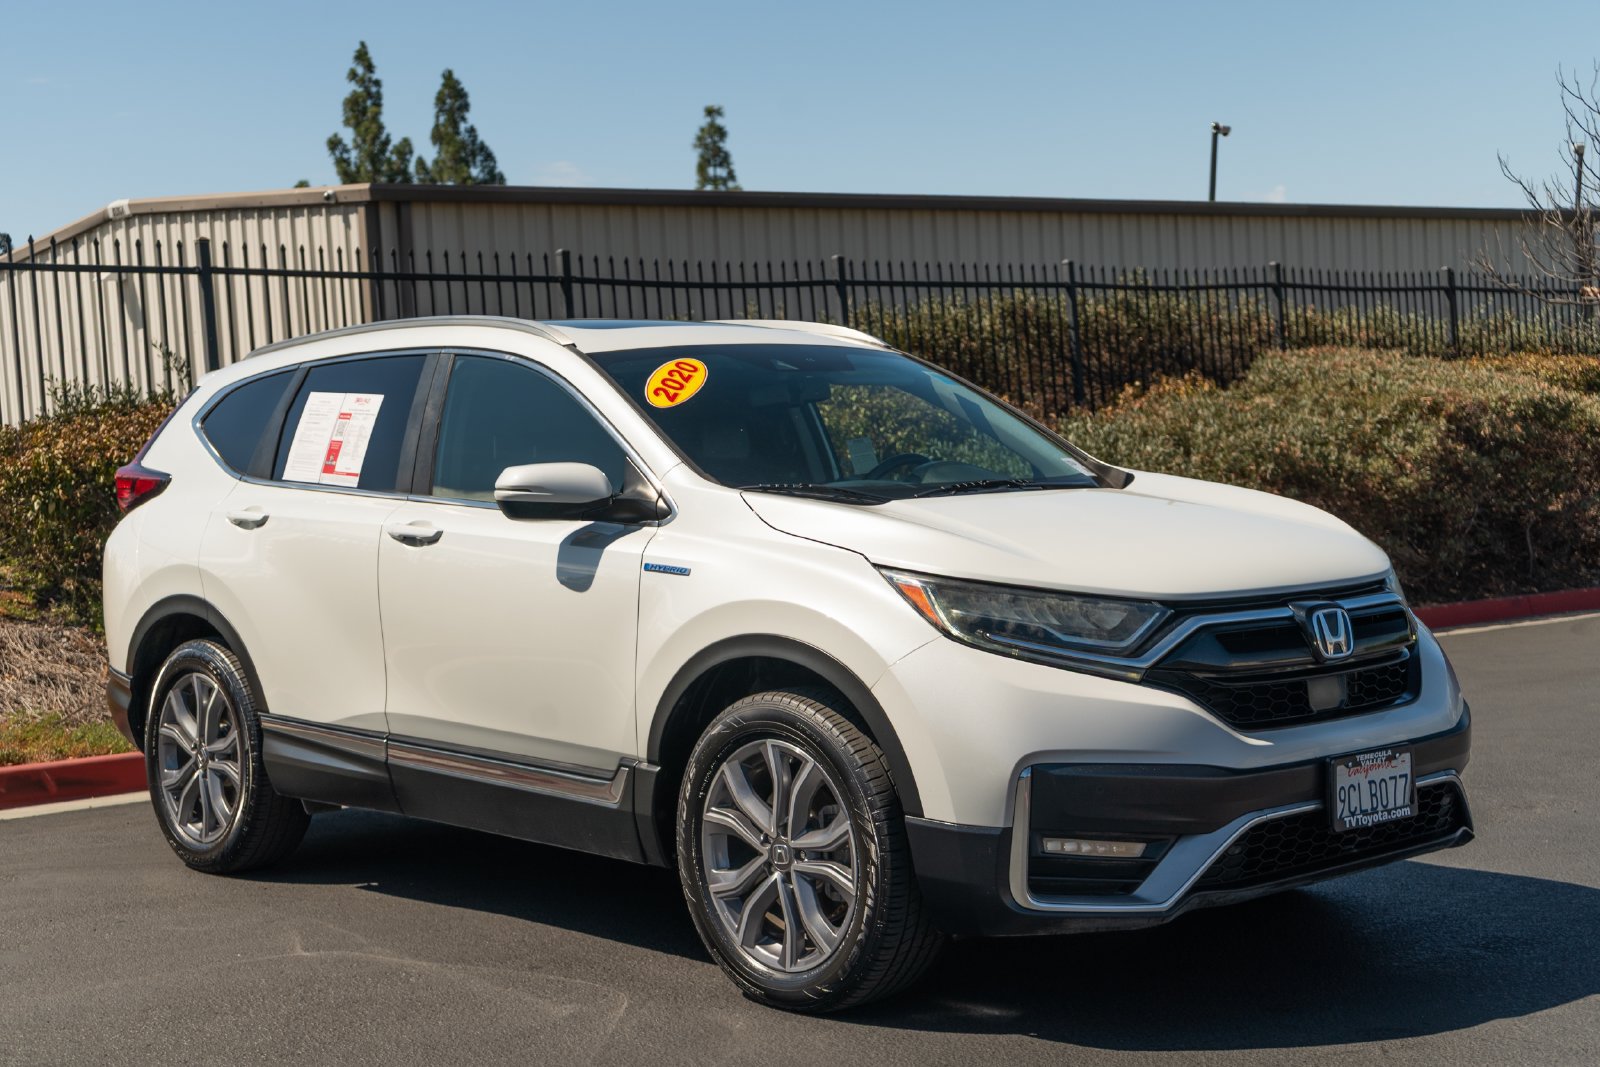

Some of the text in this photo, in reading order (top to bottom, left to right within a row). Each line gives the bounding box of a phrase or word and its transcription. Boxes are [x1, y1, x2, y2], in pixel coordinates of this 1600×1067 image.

[653, 361, 699, 403] 2020
[650, 563, 688, 574] HYBRID
[1355, 749, 1392, 762] TEMECULA
[1360, 757, 1386, 767] VALLEY
[1338, 773, 1409, 819] 9CLB077
[1344, 806, 1411, 828] TVToyota.com
